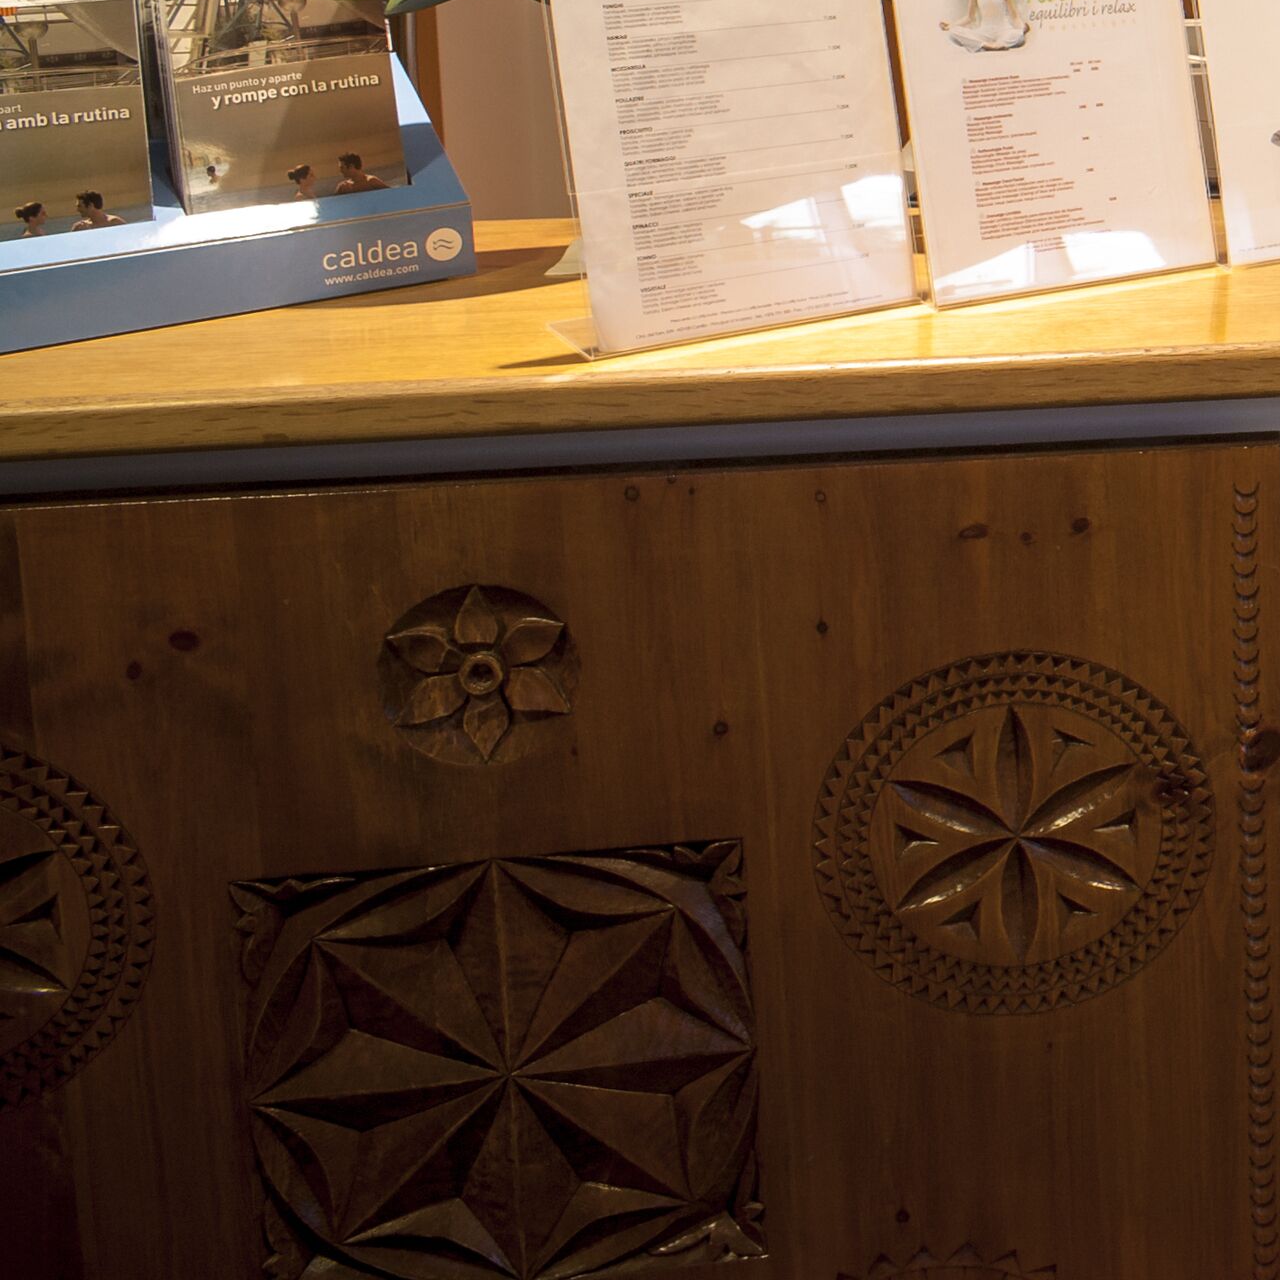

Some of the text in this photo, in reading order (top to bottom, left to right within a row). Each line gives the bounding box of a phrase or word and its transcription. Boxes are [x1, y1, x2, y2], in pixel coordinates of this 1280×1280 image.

[1029, 0, 1088, 29] equilibri
[1092, 1, 1098, 15] i
[192, 72, 303, 94] Haz un punto y aparte
[211, 73, 380, 110] y rompe con la rutina
[5, 112, 48, 130] amb
[51, 111, 71, 125] la
[73, 106, 131, 123] rutina
[322, 239, 418, 270] caldea
[324, 263, 420, 287] www.caldea.com
